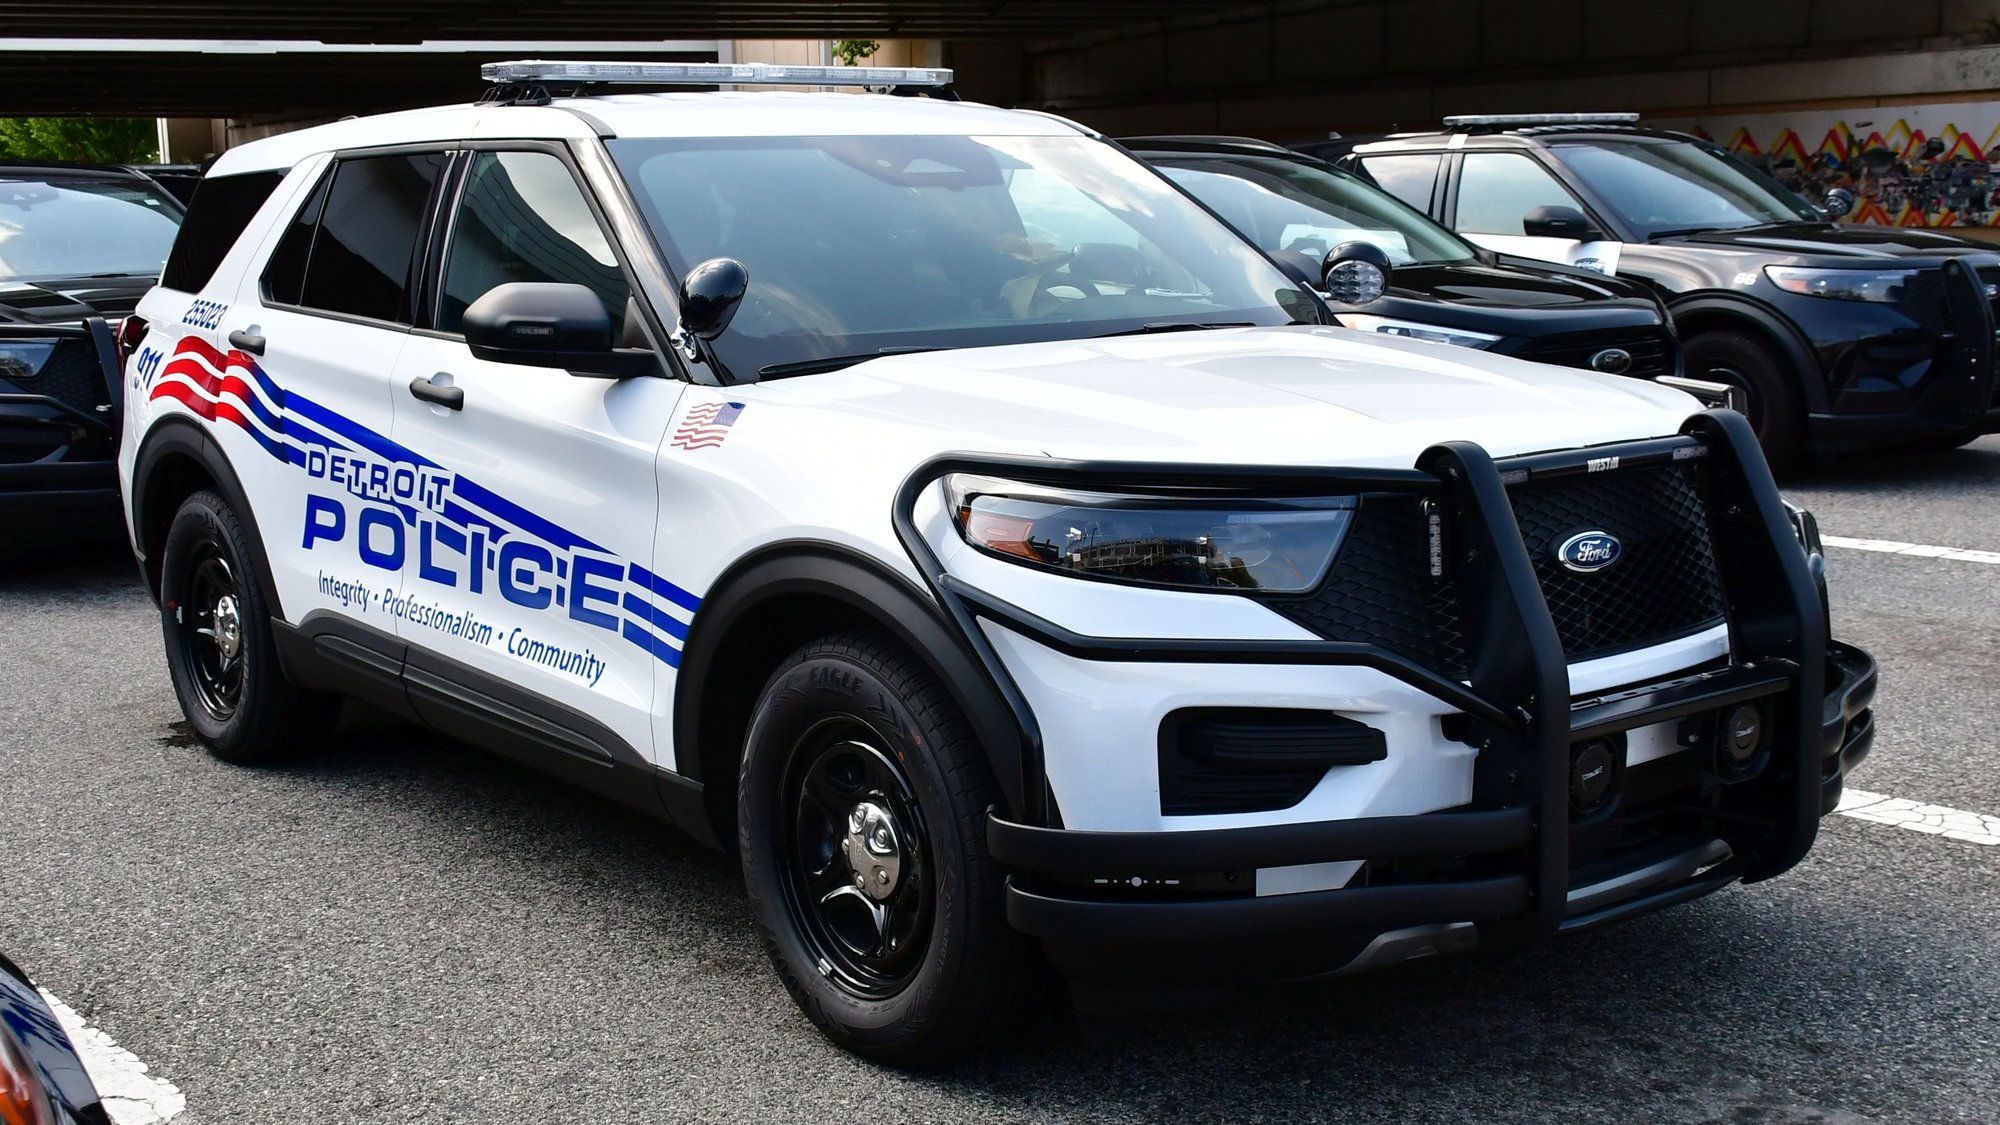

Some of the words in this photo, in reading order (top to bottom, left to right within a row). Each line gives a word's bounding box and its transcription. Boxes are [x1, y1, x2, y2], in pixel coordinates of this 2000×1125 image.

[182, 299, 228, 330] 255023
[138, 347, 164, 391] 911
[308, 451, 450, 505] DETROIT
[302, 494, 625, 632] POLICE
[1577, 539, 1611, 562] Ford
[318, 570, 370, 612] Integrity
[382, 588, 492, 645] Professionalism
[507, 627, 606, 688] Community
[808, 666, 864, 694] EAGLE
